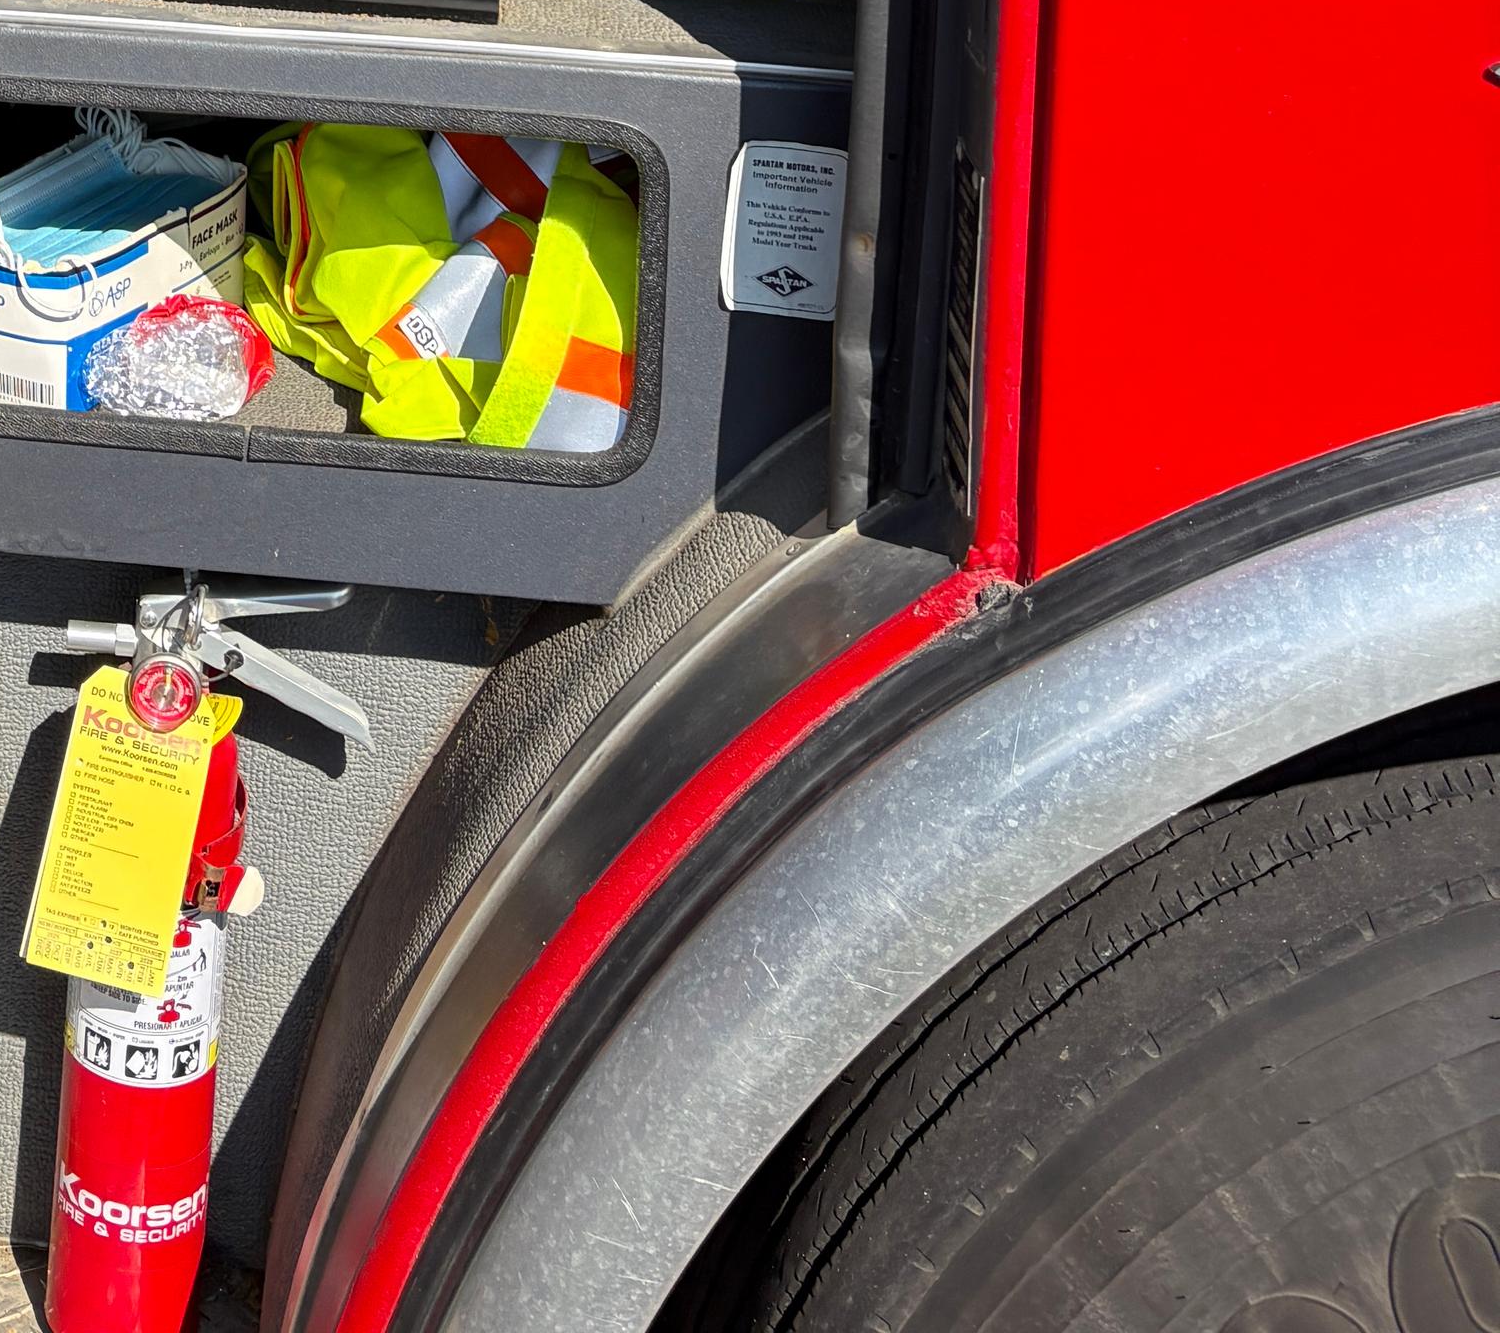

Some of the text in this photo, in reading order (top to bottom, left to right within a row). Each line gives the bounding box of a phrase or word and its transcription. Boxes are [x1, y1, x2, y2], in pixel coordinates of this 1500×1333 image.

[752, 159, 836, 176] SPARTAN MOTORS, INC.
[753, 171, 833, 187] Important Vehicle
[765, 180, 818, 194] Information
[746, 200, 761, 208] This
[762, 202, 787, 211] Vehicle
[788, 205, 822, 215] Conforms
[192, 225, 214, 249] FACE
[216, 208, 238, 235] MASK
[748, 219, 825, 234] Regulations Applicable
[783, 231, 796, 240] and
[752, 237, 817, 252] Model Year Trucks
[762, 275, 808, 288] SPATAN
[105, 277, 131, 308] ASP
[406, 315, 439, 355] DSP
[92, 686, 123, 702] DO NO
[82, 705, 201, 753] Koorsen
[80, 725, 200, 765] FIRE & SECURITY
[101, 744, 178, 771] www.Koorsen.com
[165, 981, 194, 993] APUNTAR
[122, 993, 131, 1003] TO
[59, 1160, 207, 1228] Koorsen
[57, 1193, 206, 1244] FIRE & SECURITY
